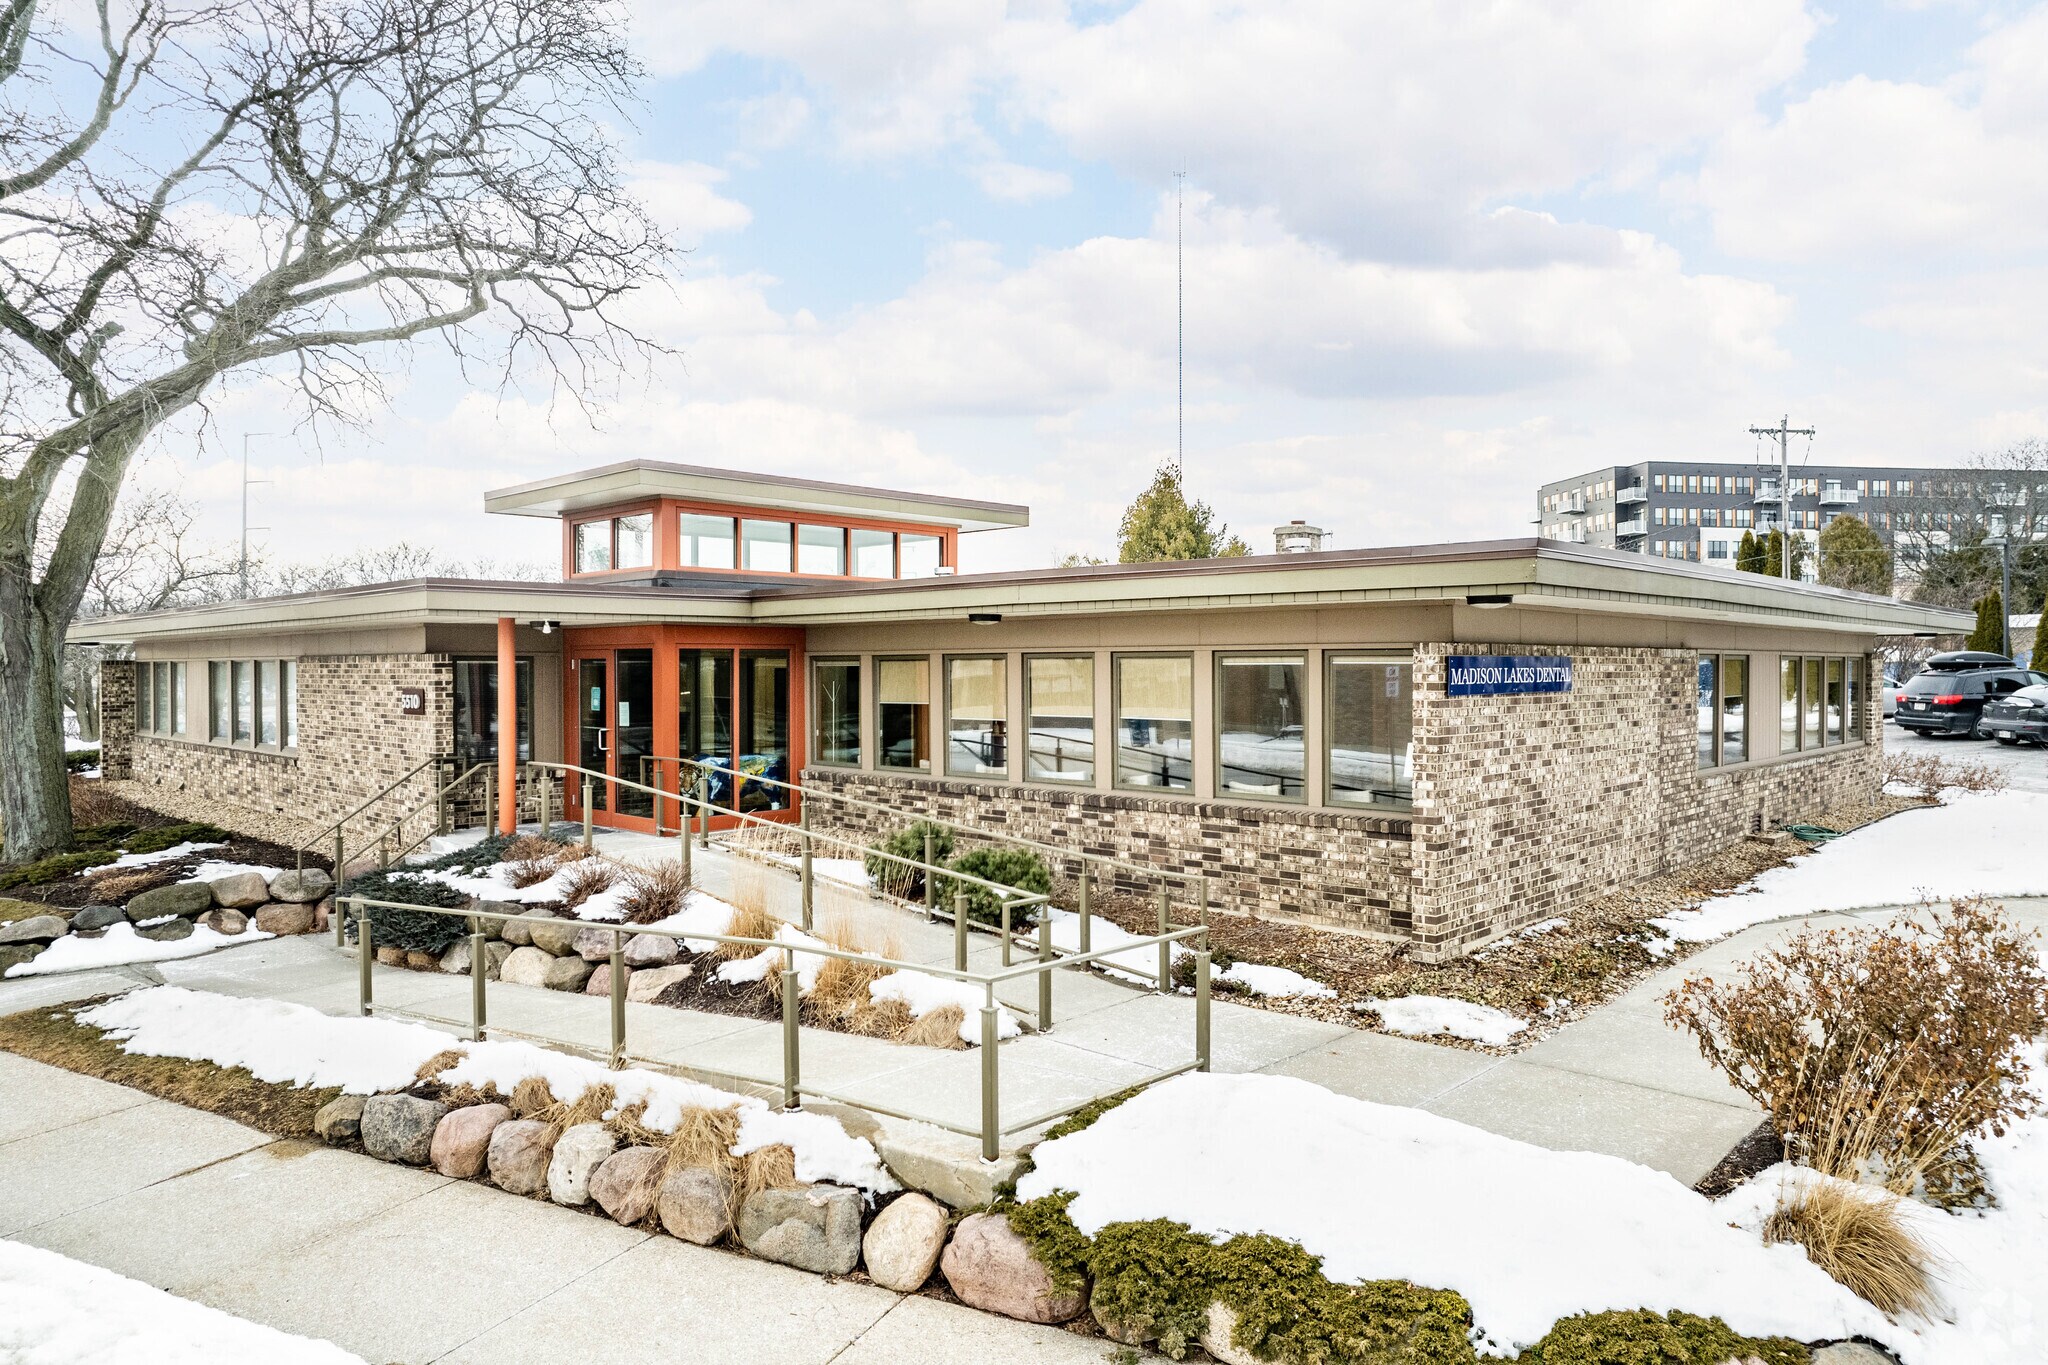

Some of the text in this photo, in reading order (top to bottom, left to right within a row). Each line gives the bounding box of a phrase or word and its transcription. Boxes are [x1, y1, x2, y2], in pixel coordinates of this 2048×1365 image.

[1450, 667, 1571, 685] MADISON LAKES DENTAL
[401, 694, 420, 709] 5510
